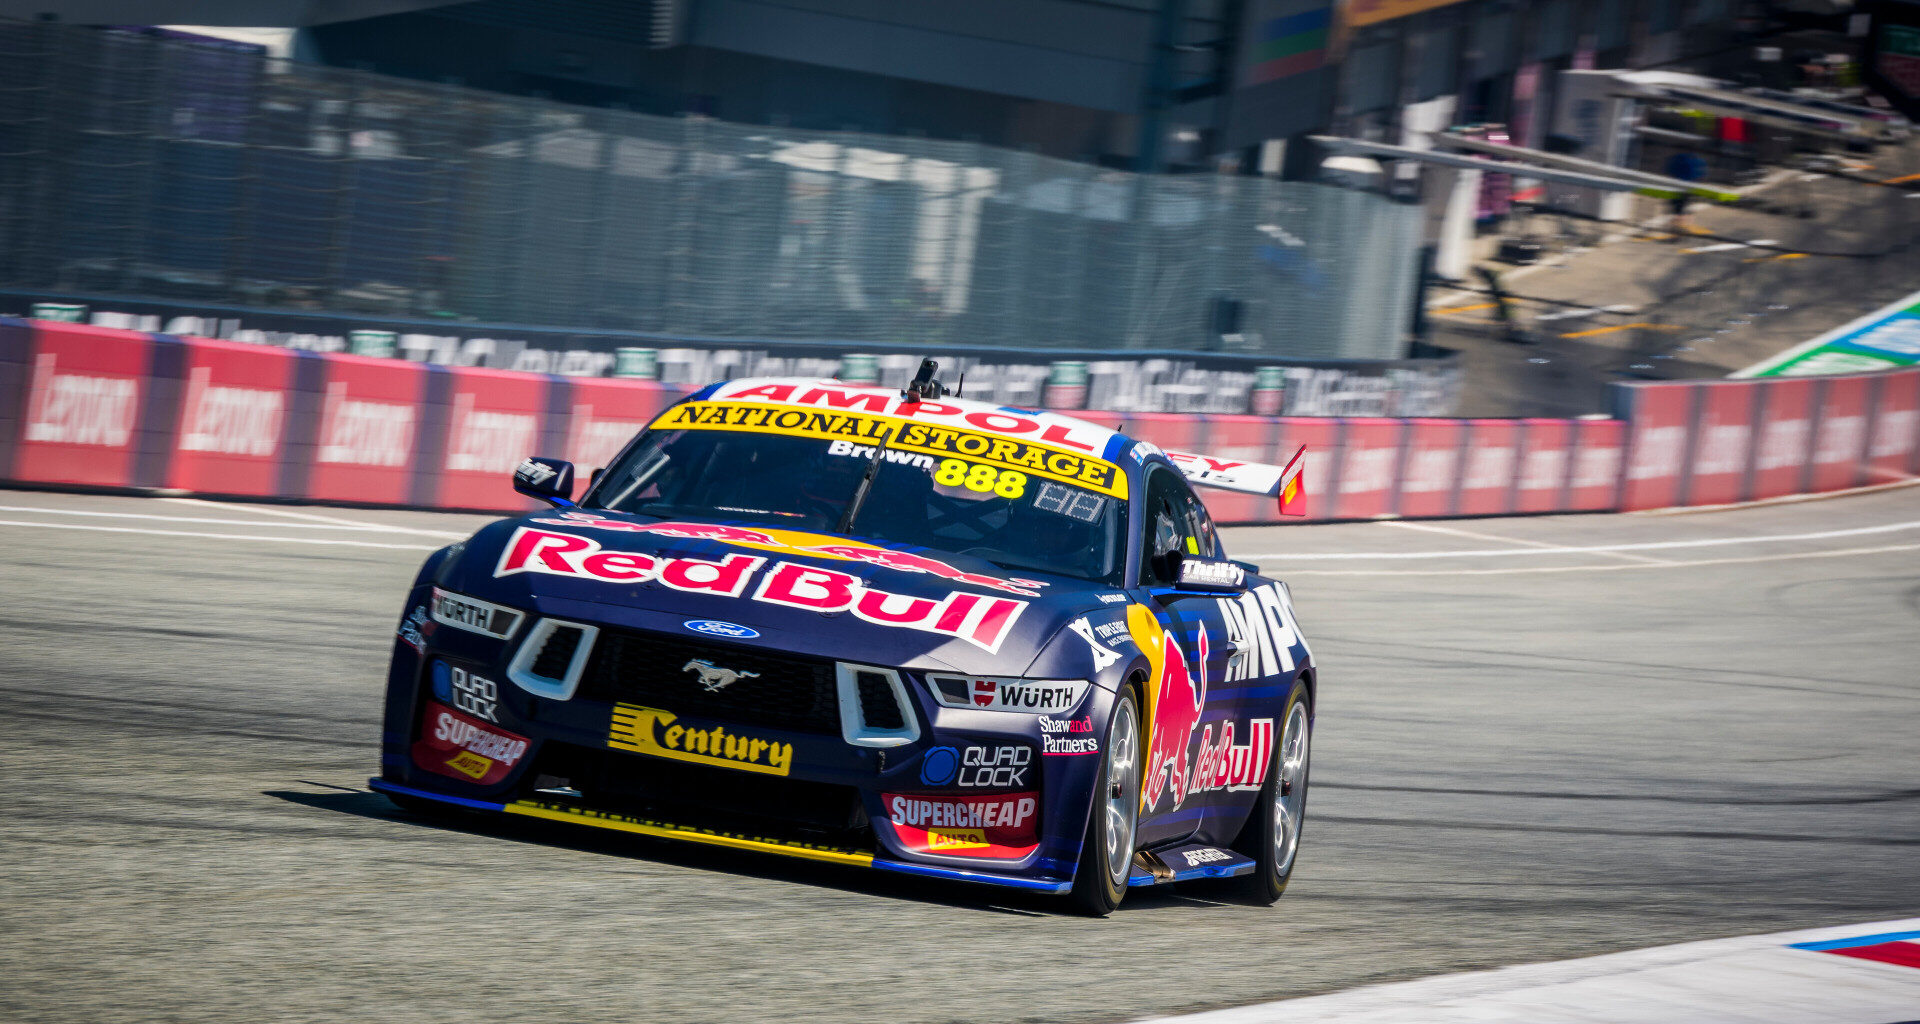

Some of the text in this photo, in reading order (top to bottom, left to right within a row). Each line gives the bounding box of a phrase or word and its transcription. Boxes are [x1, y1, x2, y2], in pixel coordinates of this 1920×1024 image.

[724, 384, 1095, 452] AMPOL
[672, 406, 888, 439] NATIONAL
[903, 425, 1109, 484] STORAGE
[828, 439, 935, 470] Brown
[934, 458, 1028, 499] 888
[1182, 559, 1245, 586] Thrifty
[493, 526, 1030, 656] Red Bull
[697, 621, 747, 637] Ford
[451, 666, 498, 701] QUAD
[1000, 684, 1074, 708] WÜRTH
[452, 686, 500, 724] LOCK
[433, 711, 528, 767] SUPERCHEAP
[645, 708, 794, 777] Century
[962, 745, 1032, 767] QUAD
[1041, 733, 1099, 753] Partners
[1187, 717, 1274, 795] Red Bull
[957, 767, 1028, 787] LOCK
[891, 795, 1036, 829] SUPERCHEAP
[934, 832, 982, 847] AUTO
